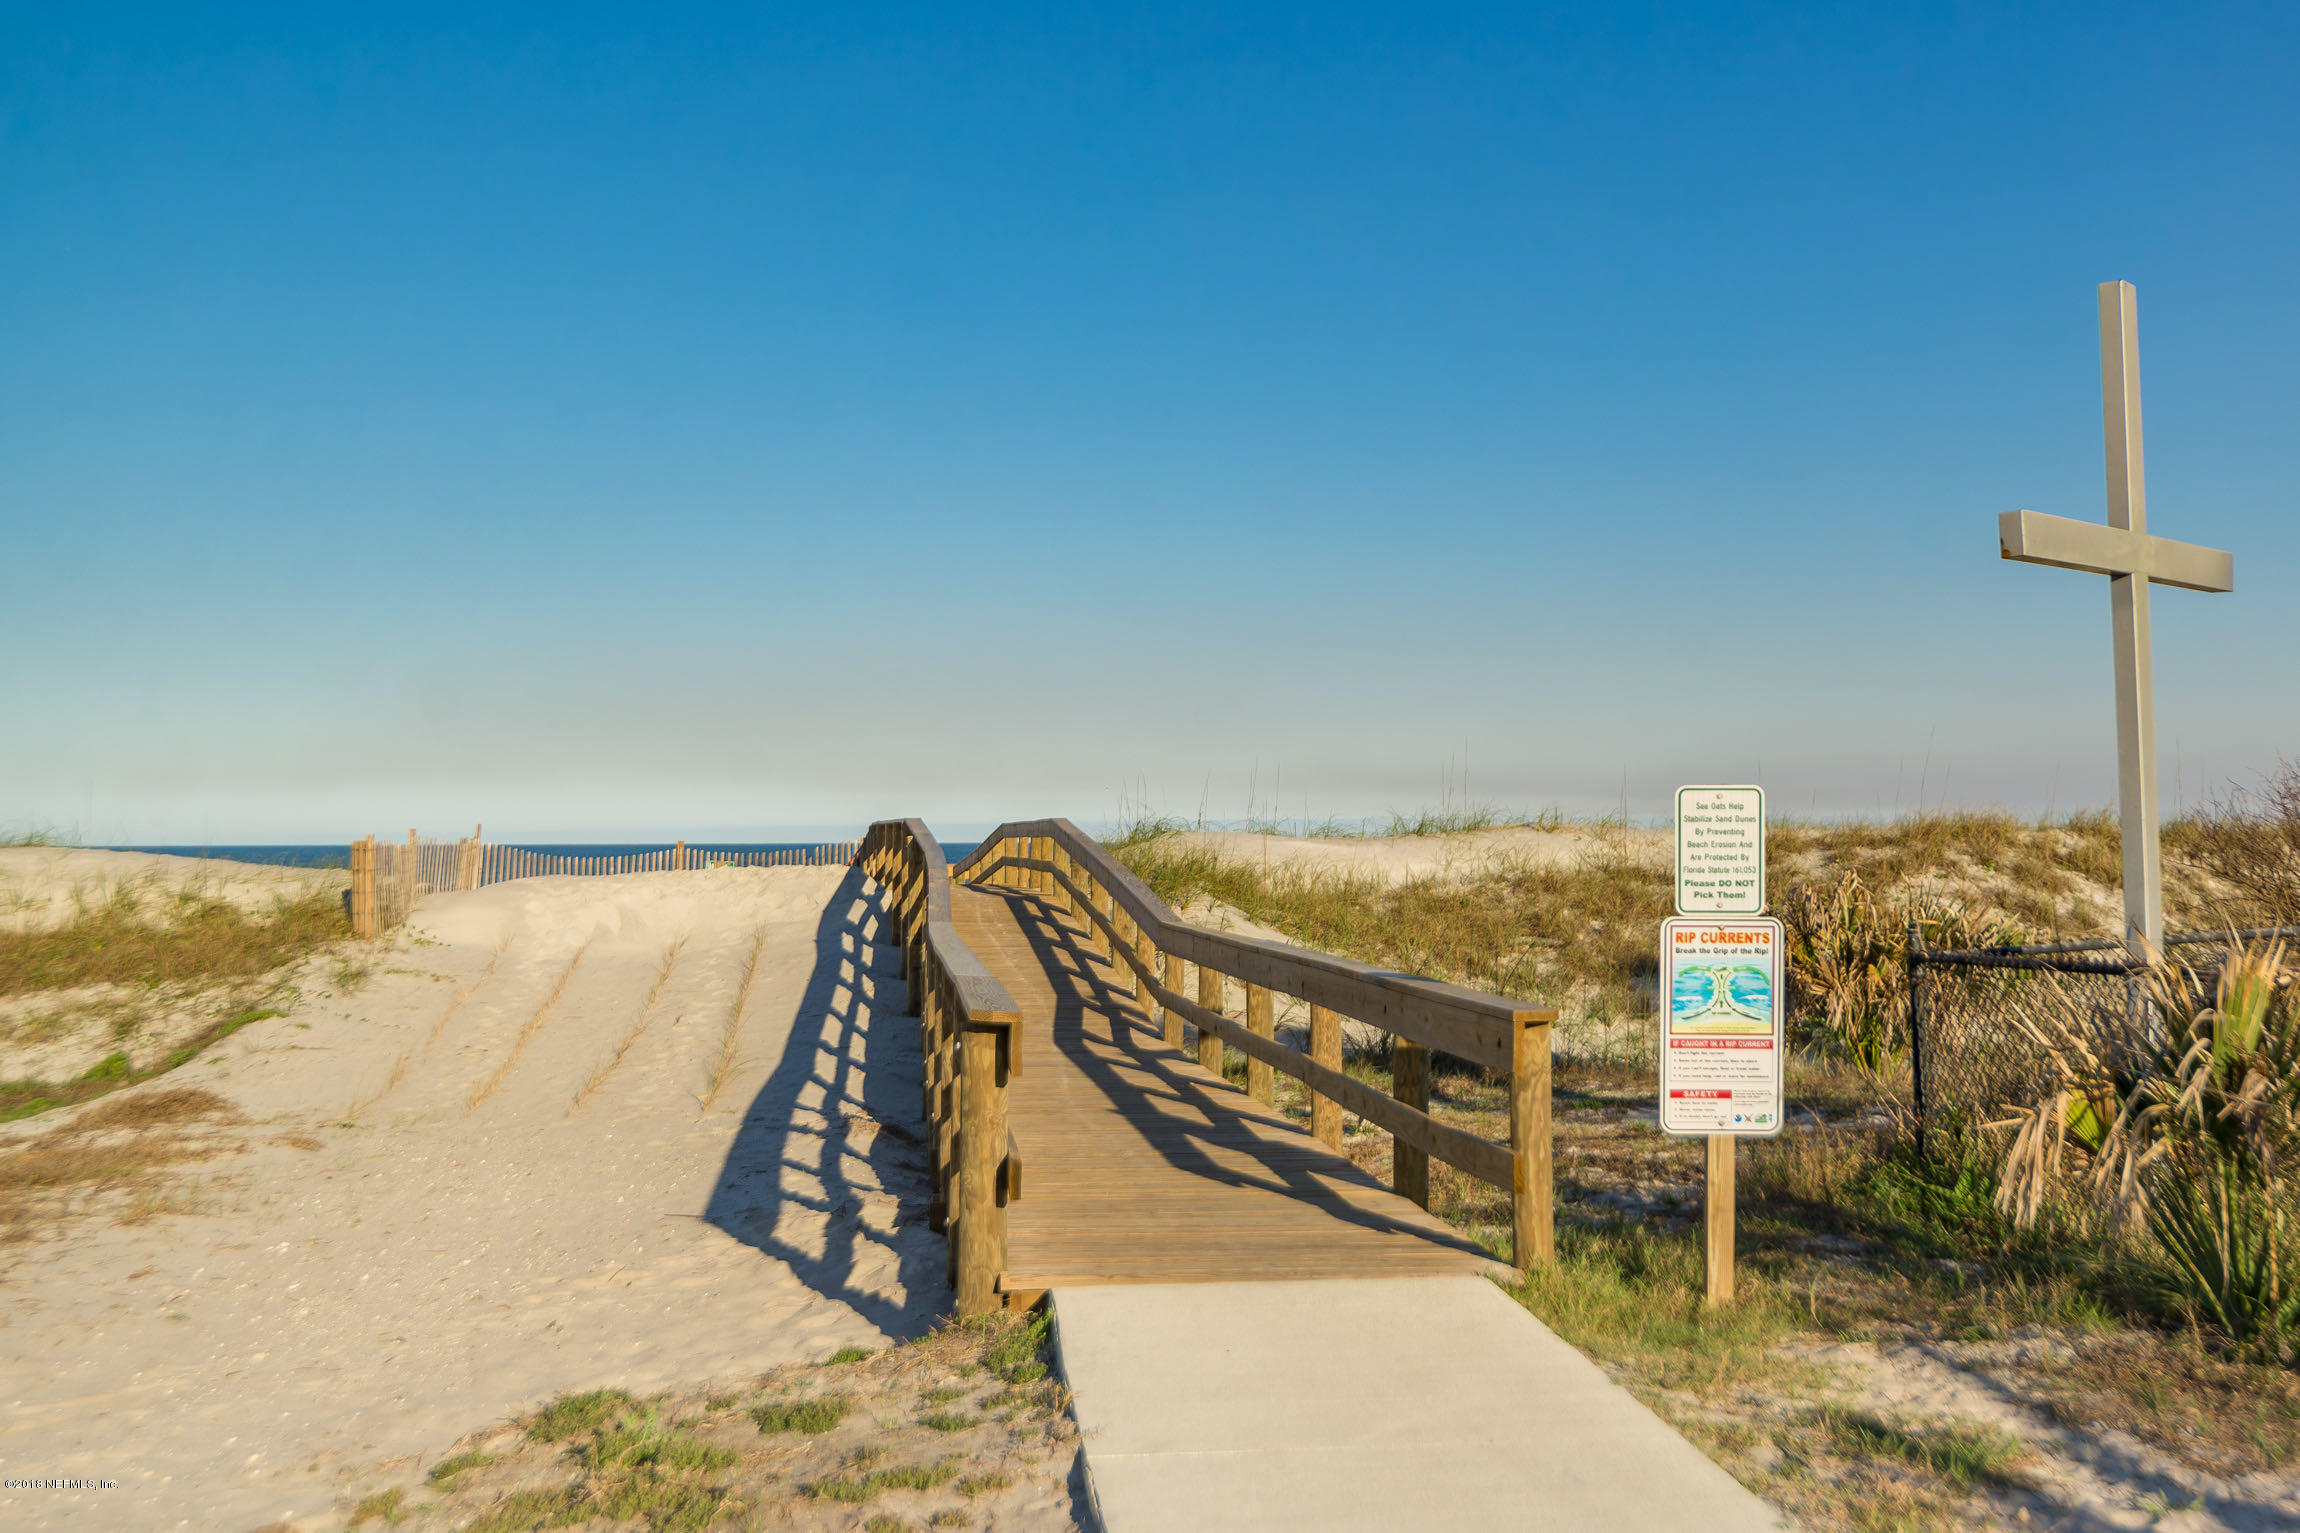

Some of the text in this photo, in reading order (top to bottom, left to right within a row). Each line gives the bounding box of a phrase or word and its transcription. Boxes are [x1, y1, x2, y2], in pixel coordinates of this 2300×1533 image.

[1711, 802, 1726, 810] Oats
[1729, 802, 1744, 811] Help
[1707, 828, 1744, 836] Preventing
[1741, 854, 1749, 862] By
[1684, 866, 1705, 874] Florida
[1708, 866, 1730, 874] Statute
[1676, 932, 1770, 944] RIP CURRENTS
[1754, 947, 1768, 955] Rip!
